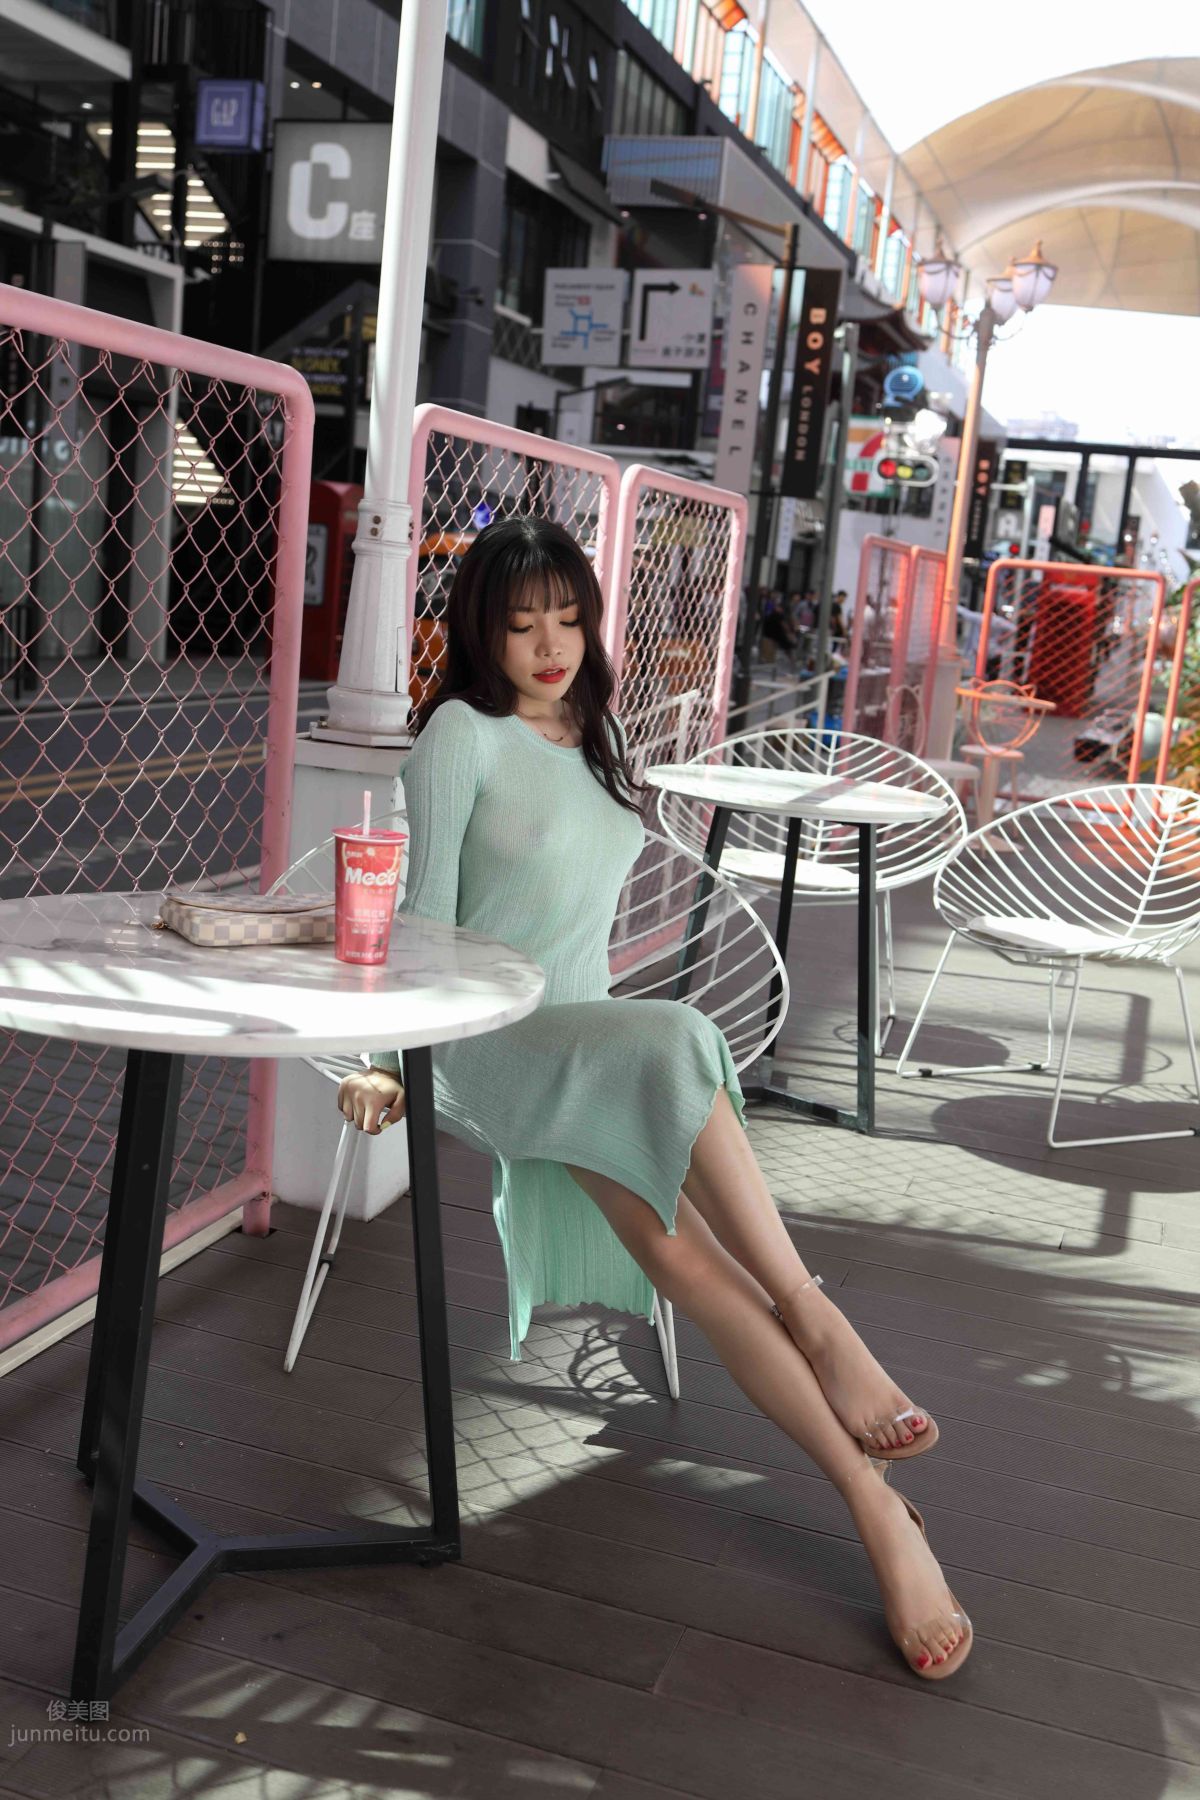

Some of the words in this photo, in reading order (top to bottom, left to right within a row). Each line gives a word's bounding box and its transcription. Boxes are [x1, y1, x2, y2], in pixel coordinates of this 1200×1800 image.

[804, 308, 827, 375] BOY
[729, 303, 757, 456] CHANEL
[795, 385, 813, 461] LONDON
[345, 867, 397, 886] Meco
